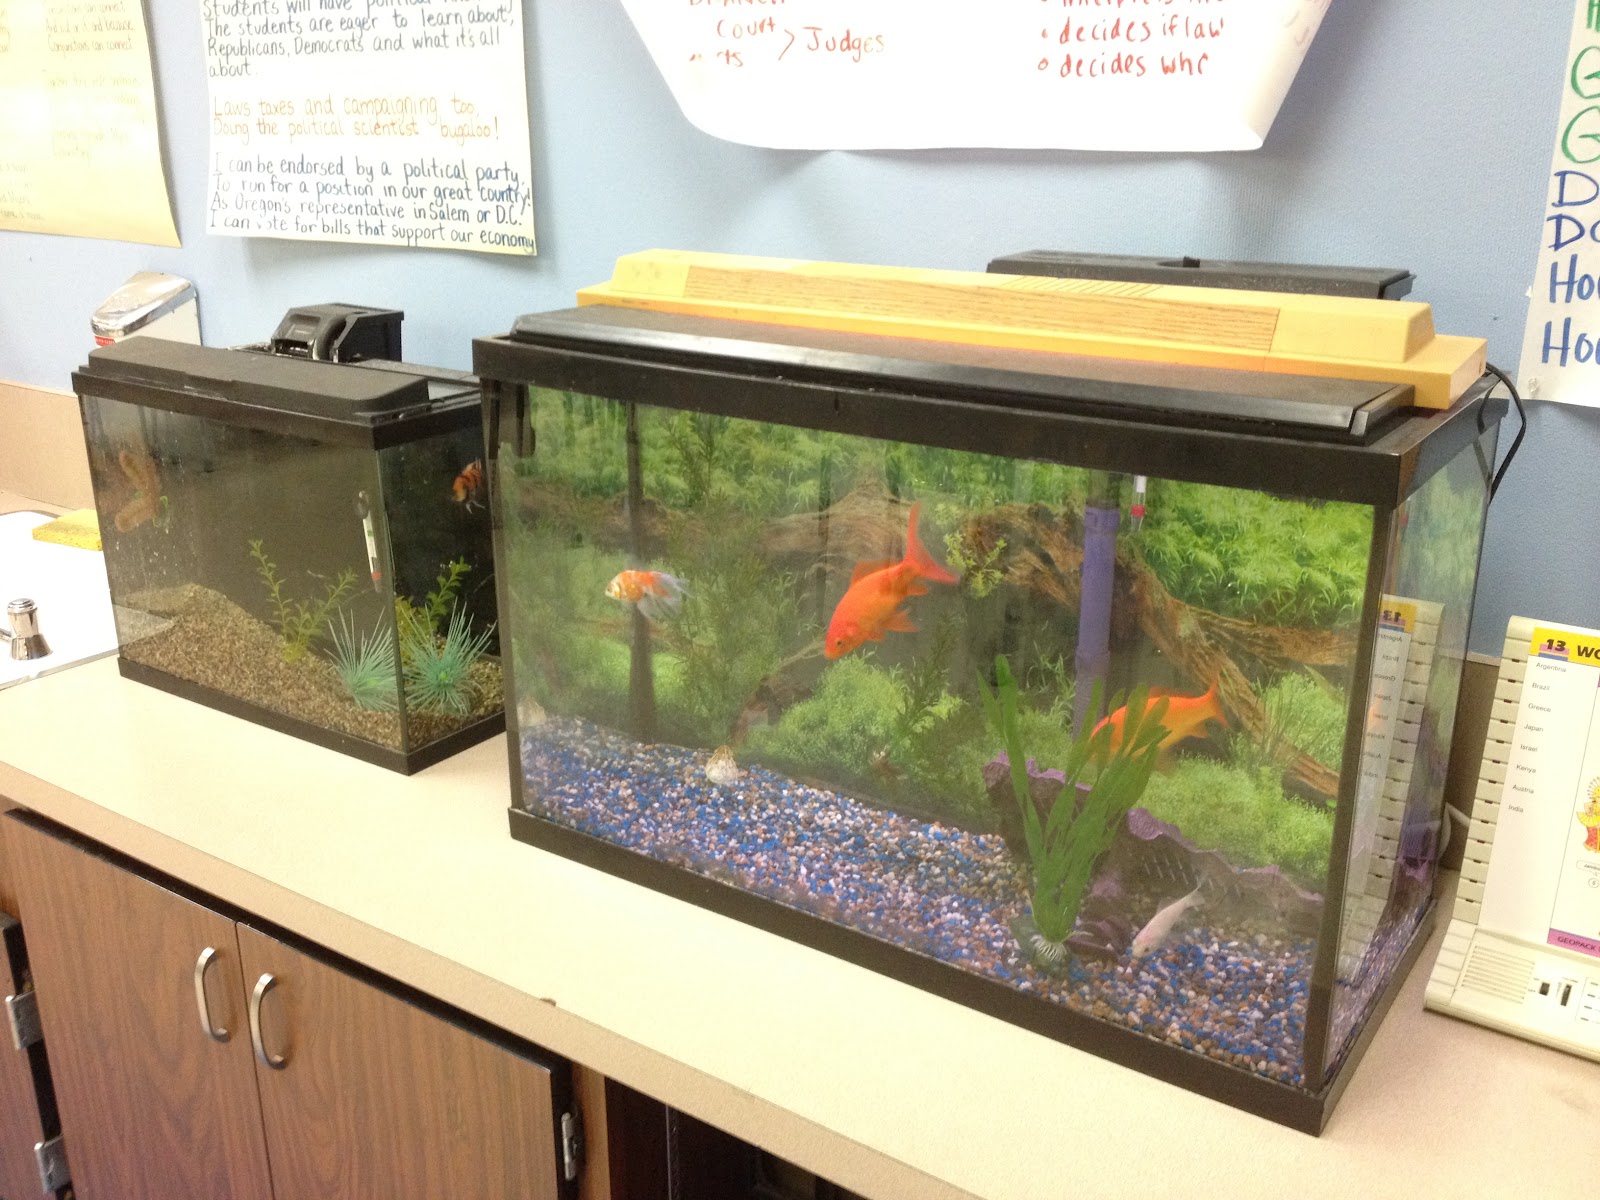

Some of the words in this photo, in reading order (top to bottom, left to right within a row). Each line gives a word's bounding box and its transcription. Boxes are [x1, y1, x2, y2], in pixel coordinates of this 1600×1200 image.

[203, 0, 279, 17] Students
[286, 0, 311, 14] will
[205, 17, 231, 36] The
[238, 17, 303, 35] students
[309, 17, 334, 32] are
[340, 17, 378, 39] eager
[392, 9, 408, 28] to
[421, 8, 463, 27] learn
[467, 5, 514, 26] about,
[1060, 17, 1151, 44] decides
[1162, 14, 1178, 36] if
[1185, 16, 1224, 38] law
[208, 37, 291, 64] Republicans,
[294, 32, 364, 55] Democrats
[373, 33, 405, 51] and
[412, 28, 450, 49] what
[456, 26, 475, 48] it's
[479, 25, 500, 46] all
[803, 27, 884, 62] Judges
[1060, 53, 1146, 78] decides
[214, 96, 251, 117] Laws
[258, 98, 295, 116] taxes
[304, 94, 334, 115] and
[343, 96, 438, 125] campaigning
[213, 117, 250, 145] Doing
[256, 118, 279, 135] the
[289, 119, 345, 144] political
[354, 116, 419, 136] scientist
[440, 116, 499, 146] bugaloo!
[214, 152, 224, 172] I
[229, 159, 252, 172] can
[257, 154, 274, 173] be
[280, 153, 345, 176] endorsed
[355, 155, 374, 183] by
[381, 161, 392, 176] a
[403, 157, 469, 185] political
[213, 173, 230, 192] To
[242, 180, 265, 193] run
[270, 174, 293, 193] for
[299, 180, 309, 193] a
[316, 177, 373, 204] position
[384, 184, 397, 198] in
[402, 186, 427, 200] our
[434, 180, 473, 207] great
[480, 184, 531, 216] country!
[211, 191, 228, 211] As
[235, 192, 291, 218] Oregon's
[300, 198, 405, 220] representative
[414, 202, 426, 219] in
[429, 202, 470, 223] Salem
[477, 209, 491, 223] or
[496, 204, 522, 226] D.C.
[210, 209, 217, 228] I
[224, 216, 250, 229] can
[295, 215, 317, 232] for
[322, 217, 351, 234] bills
[356, 219, 387, 236] that
[392, 219, 446, 247] support
[451, 230, 474, 243] our
[480, 229, 535, 254] economy
[1550, 254, 1600, 303] Ho
[1547, 638, 1567, 652] 13
[1536, 662, 1567, 673] Argentina
[1531, 682, 1551, 691] Brazil
[1527, 702, 1552, 713] Greece
[1523, 723, 1544, 733] Japan
[1520, 743, 1538, 753] Israel
[1515, 764, 1537, 774] Kenya
[1512, 784, 1535, 795] Austria
[1508, 804, 1525, 813] India
[1556, 936, 1597, 951] GEOPACK
